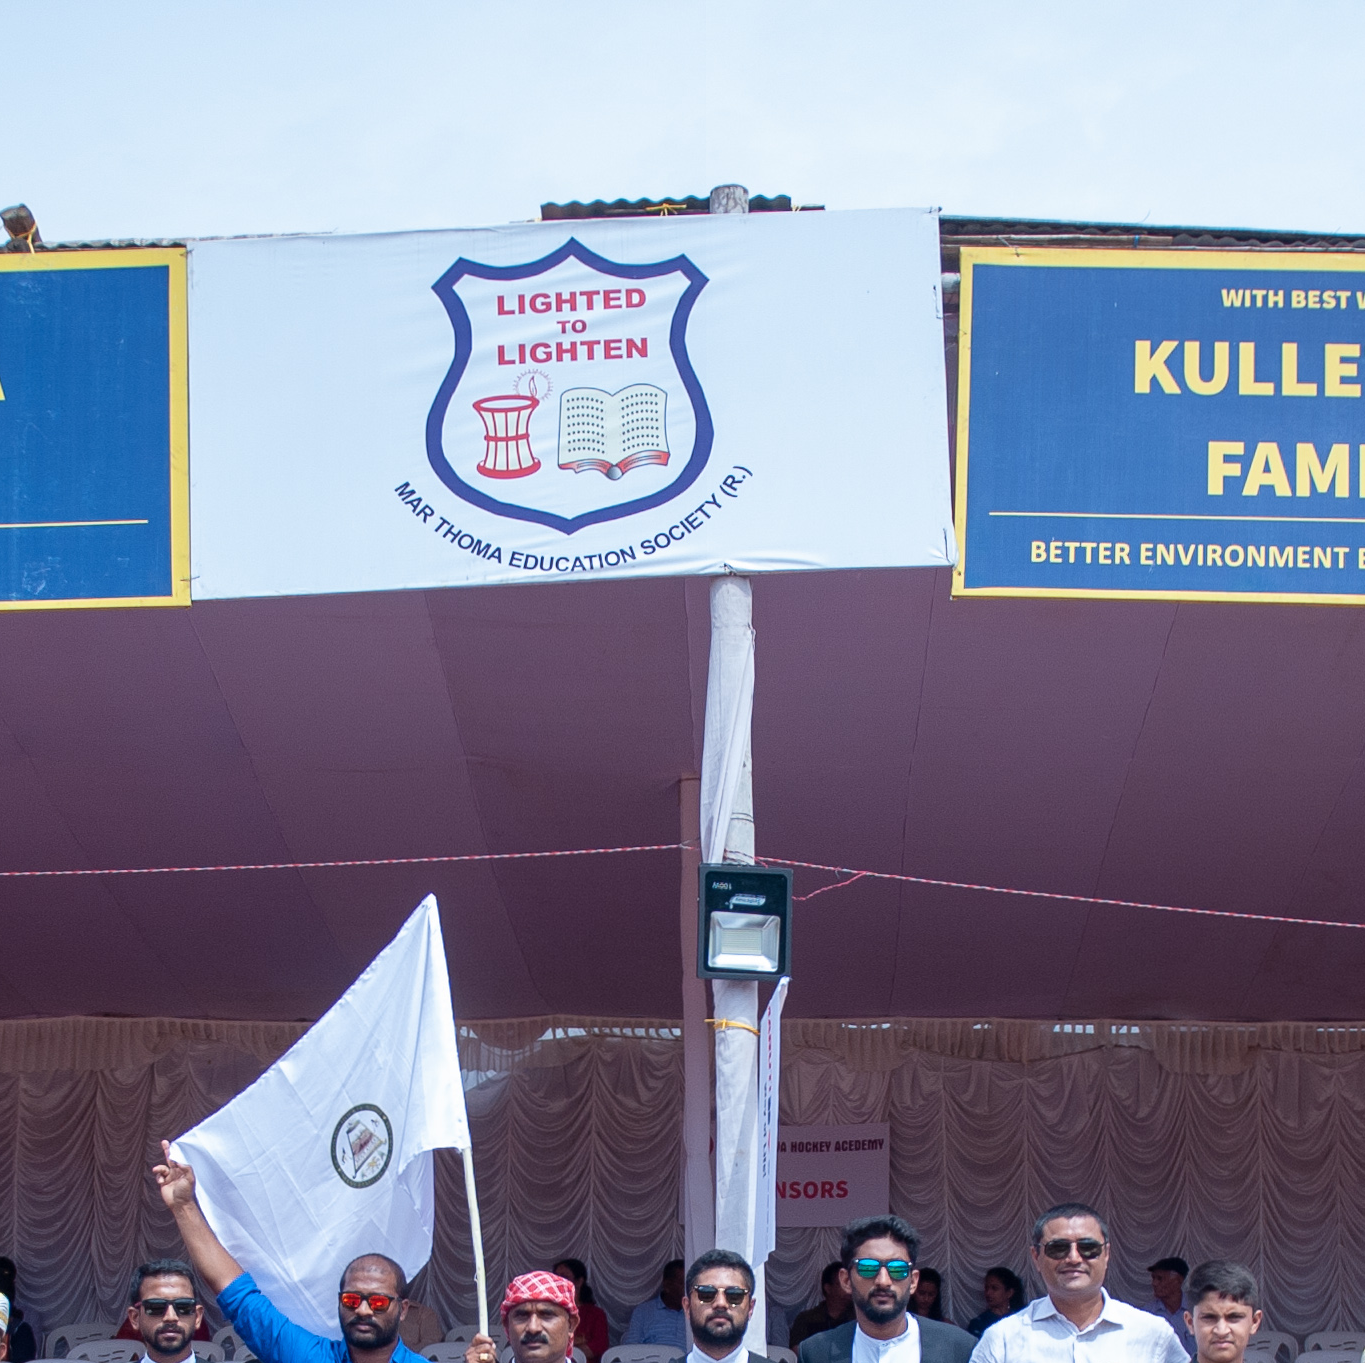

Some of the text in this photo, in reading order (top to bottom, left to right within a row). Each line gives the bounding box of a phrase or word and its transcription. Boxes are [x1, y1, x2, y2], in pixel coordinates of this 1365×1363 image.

[496, 287, 647, 316] LIGHTED
[1221, 288, 1284, 309] WITH
[1291, 289, 1352, 310] BEST
[556, 318, 588, 335] TO
[497, 337, 649, 366] LIGHTEN
[394, 464, 754, 572] MAR THOMA EDUCATION SOCIETY (R.)
[1030, 540, 1131, 566] BETTER
[1138, 542, 1351, 569] ENVIRONMENT
[790, 1140, 832, 1153] HOCKEY
[834, 1138, 884, 1152] ACEDEMY
